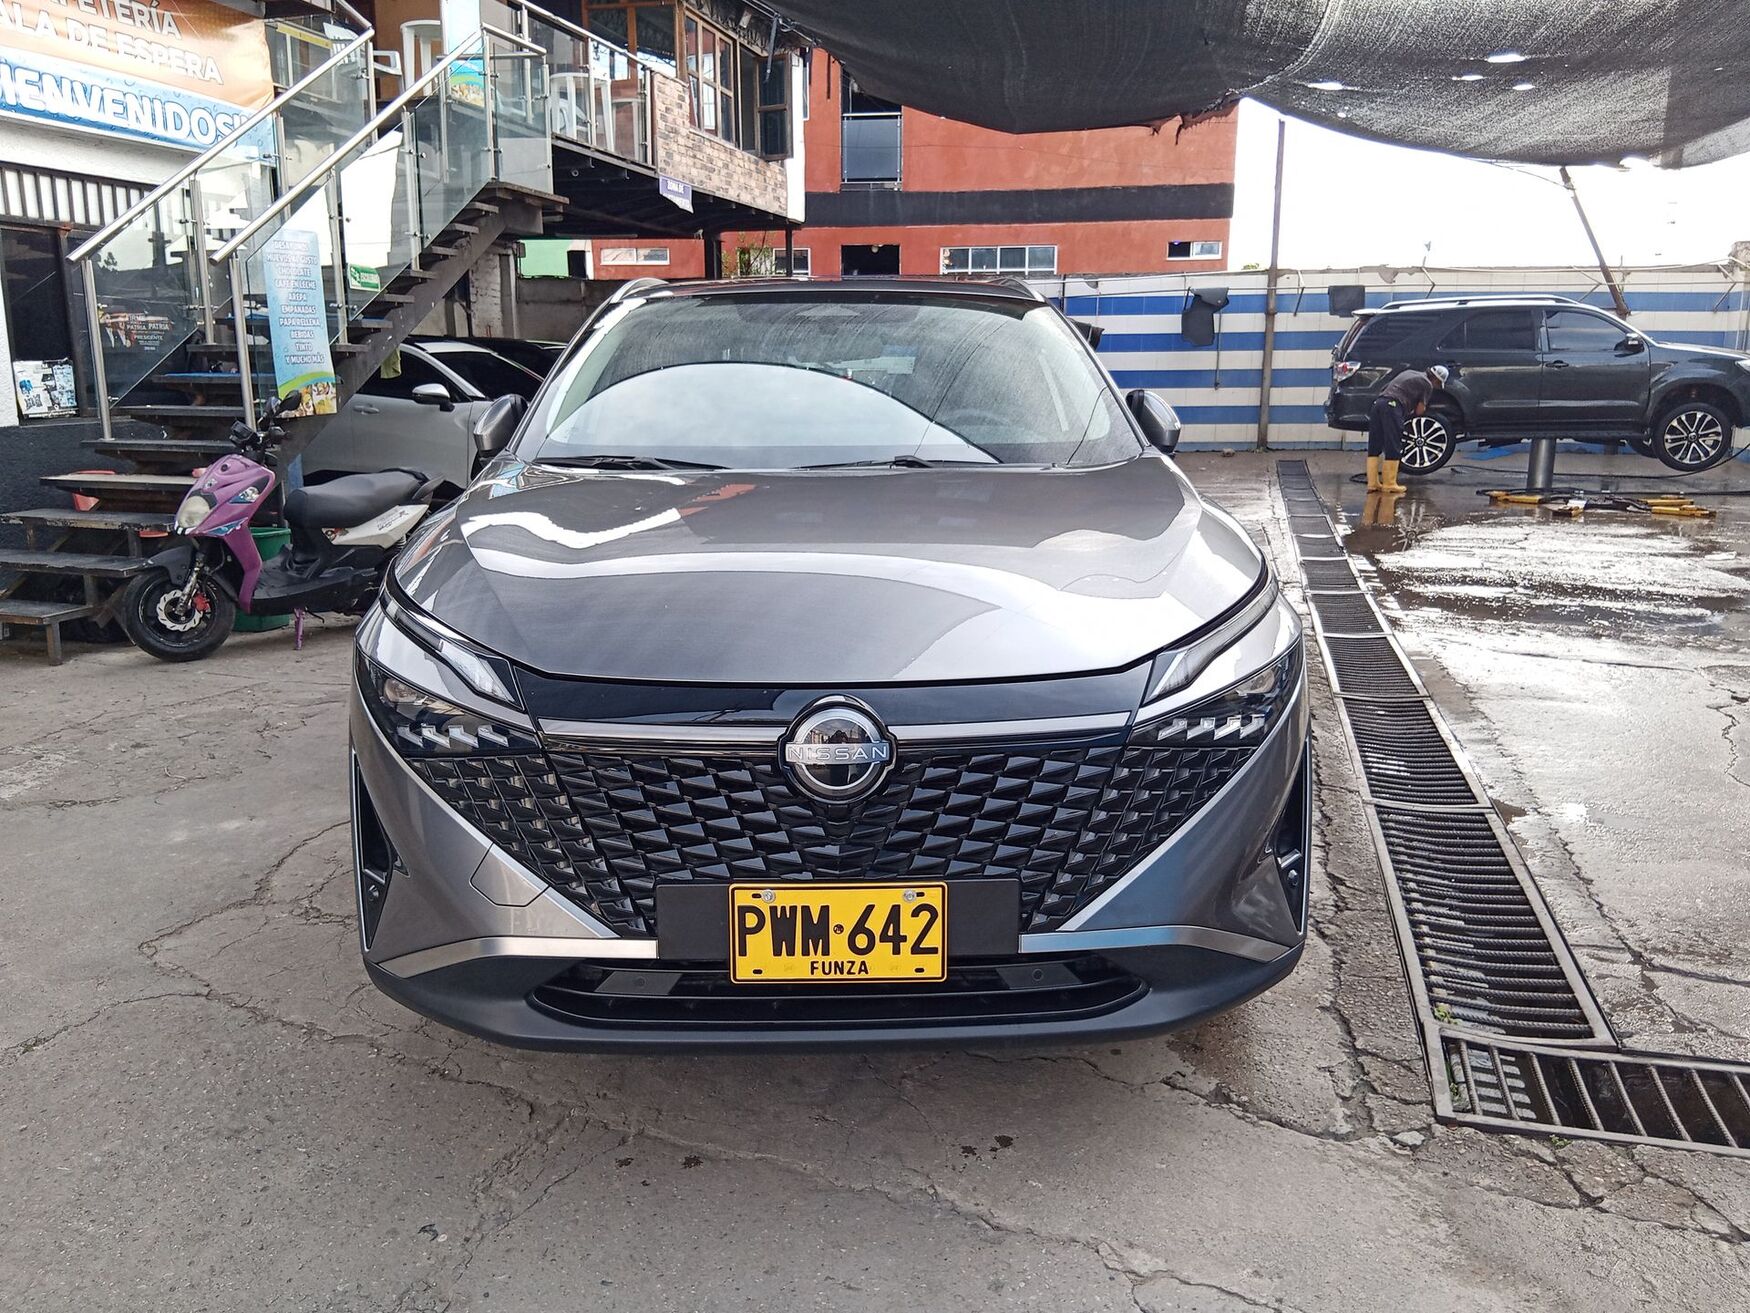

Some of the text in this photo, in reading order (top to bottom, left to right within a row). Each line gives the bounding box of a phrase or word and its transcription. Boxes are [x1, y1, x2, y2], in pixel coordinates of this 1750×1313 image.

[51, 0, 182, 40] ETERÍA
[65, 17, 111, 51] DE
[114, 31, 224, 85] ESPERA
[788, 745, 888, 761] NISSAN
[810, 961, 869, 975] FUNZA
